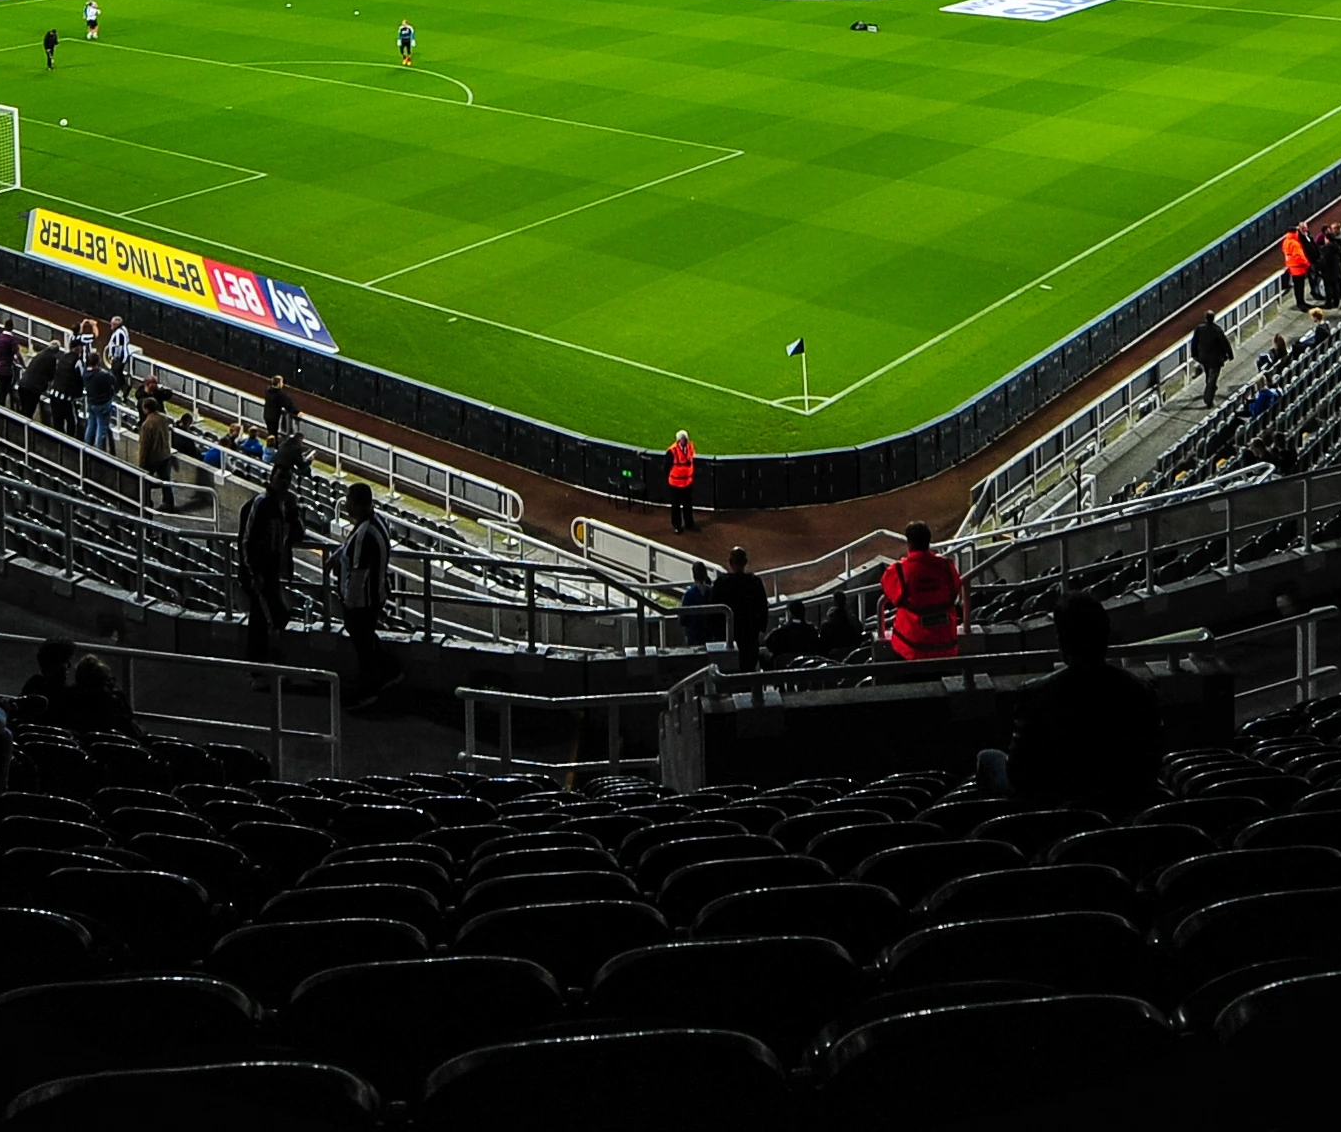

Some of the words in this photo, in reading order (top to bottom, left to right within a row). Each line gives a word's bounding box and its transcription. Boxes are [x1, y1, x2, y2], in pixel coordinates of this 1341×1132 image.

[39, 218, 107, 265] BETTER
[110, 235, 206, 296] BETTING,
[212, 268, 265, 317] BET
[266, 278, 321, 340] sky
